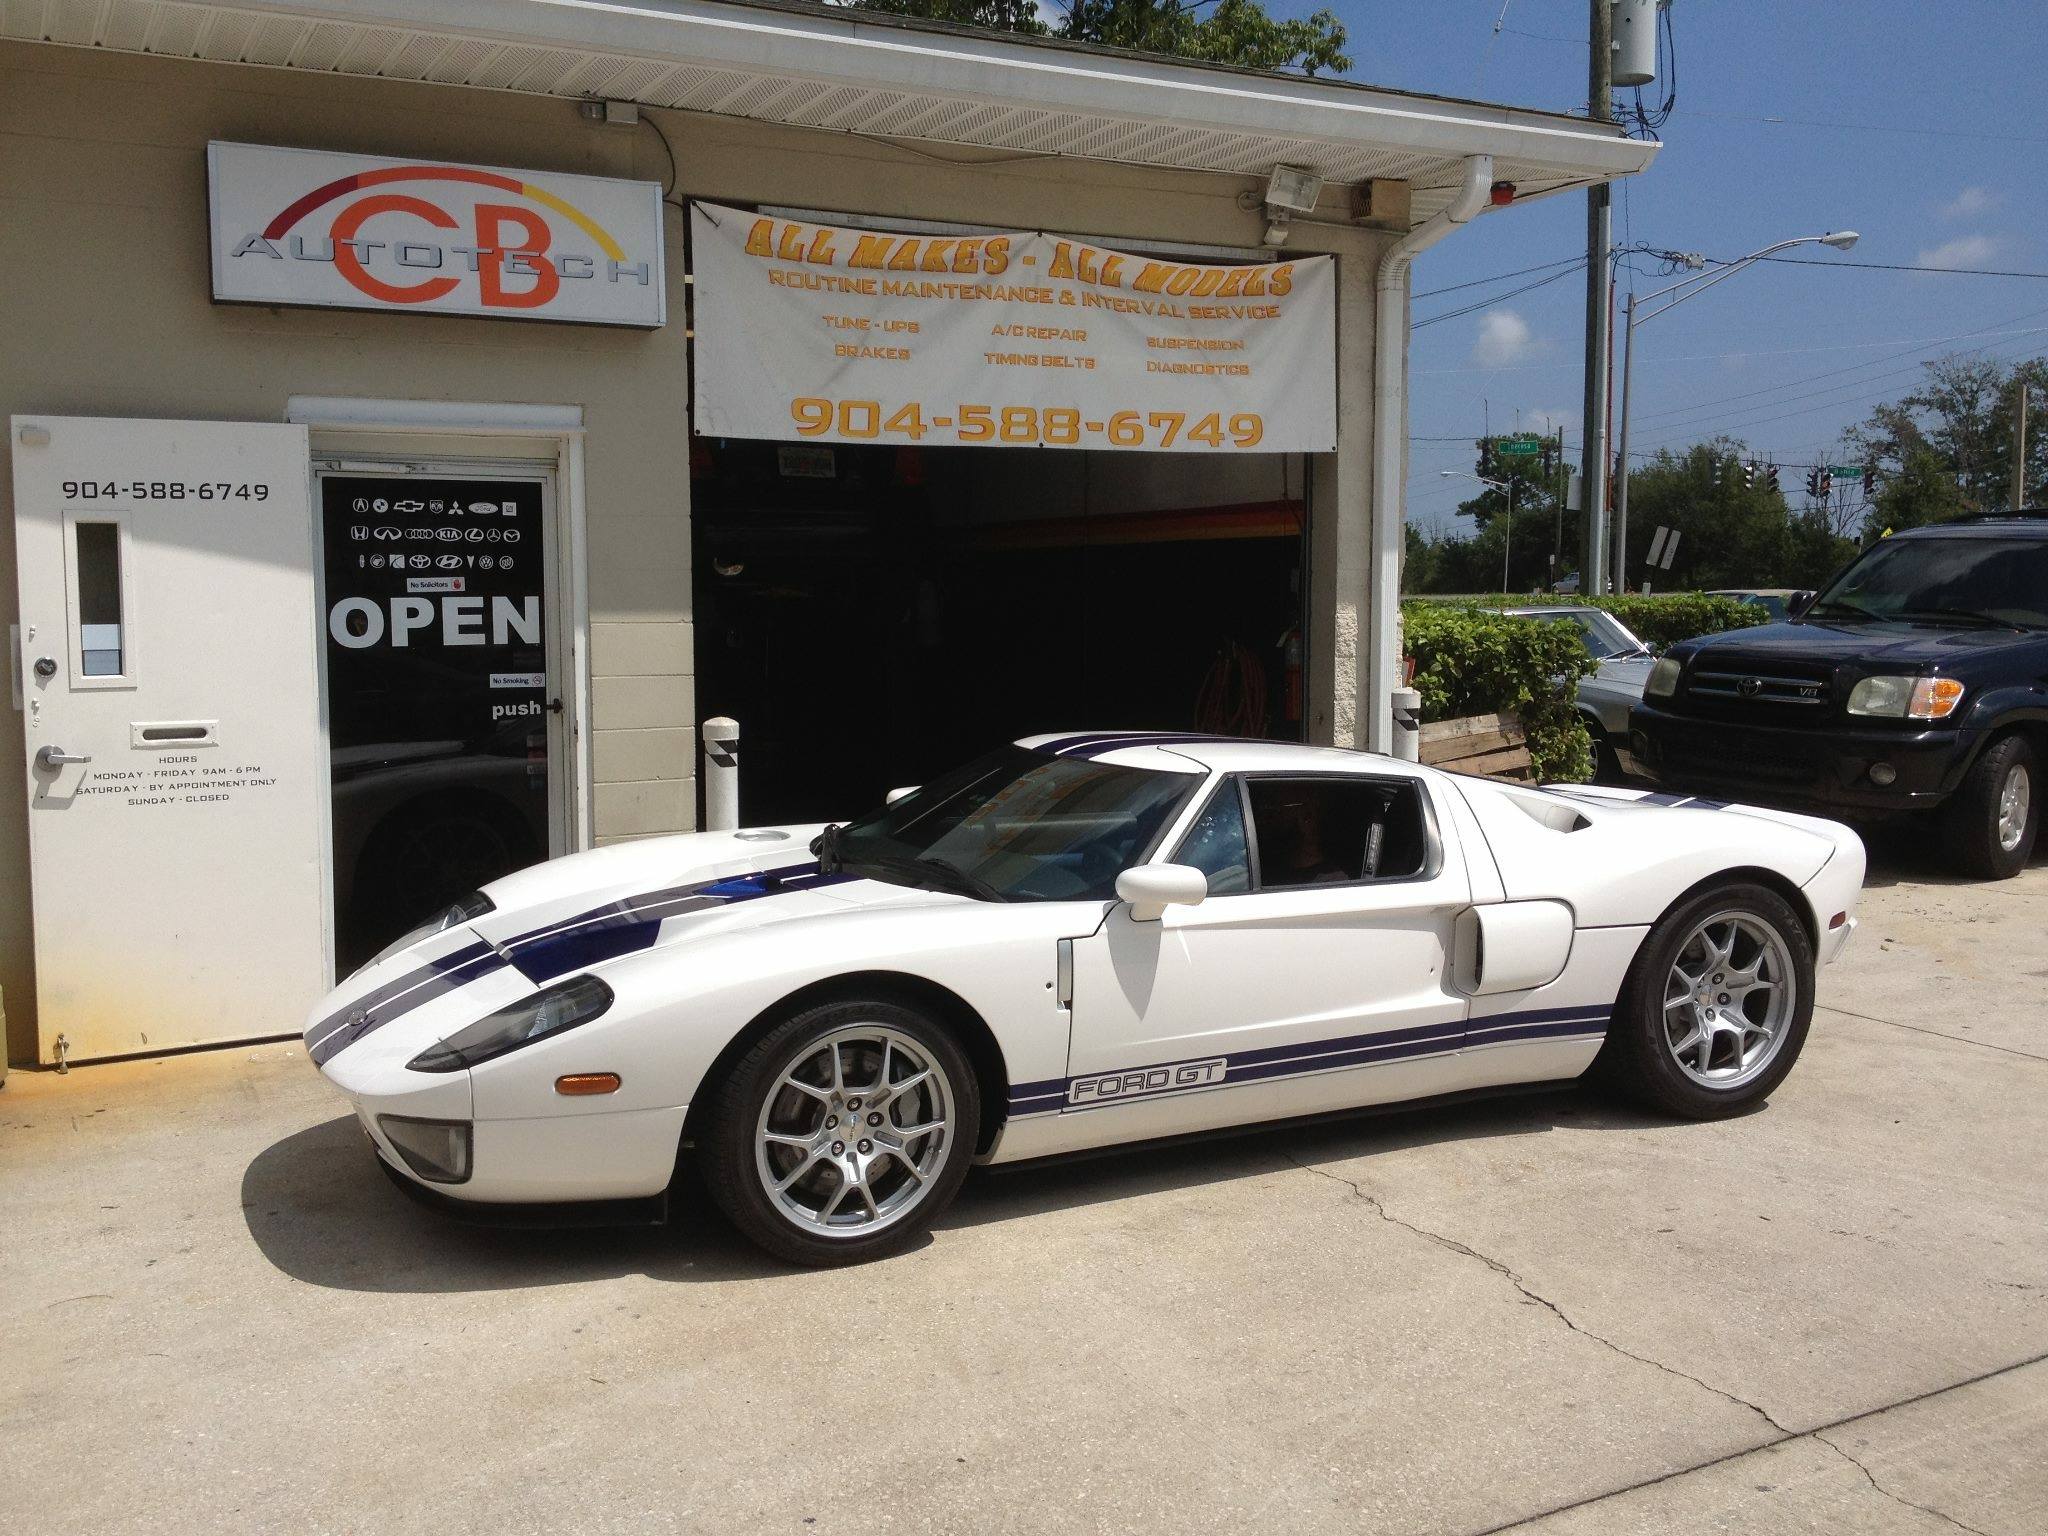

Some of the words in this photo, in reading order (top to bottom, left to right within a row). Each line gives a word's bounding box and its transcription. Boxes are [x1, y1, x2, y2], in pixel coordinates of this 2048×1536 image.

[231, 232, 649, 286] AUTOTECH
[329, 194, 560, 309] CB
[745, 218, 836, 265] ALL
[848, 235, 1010, 275] MAKES
[1048, 242, 1127, 288] ALL
[1133, 262, 1295, 298] MODELS
[768, 269, 878, 296] ROUTINE
[882, 280, 1053, 304] MAINTENANCE
[1059, 288, 1077, 306] &
[1082, 292, 1185, 319] INTERVAL
[1189, 304, 1282, 320] SERVICE
[991, 323, 1024, 336] A/C
[1026, 326, 1088, 342] REPAIR
[834, 343, 911, 361] BRAKES
[1146, 336, 1244, 351] SUSPENSION
[984, 352, 1039, 367] TIMING
[1041, 354, 1096, 370] BELTS
[1146, 360, 1250, 376] DIAGNOSTICS
[791, 397, 1264, 448] 904-588-6749
[62, 481, 269, 501] 904-588-6749
[329, 596, 541, 649] OPEN
[502, 677, 530, 685] Smoking
[1799, 687, 1818, 697] V8
[492, 700, 541, 720] push
[159, 755, 198, 764] HOURS
[93, 771, 143, 781] MONDAY
[154, 769, 196, 778] FRIDAY
[202, 768, 226, 776] 9AM
[76, 785, 139, 795] SATURDAY
[168, 779, 247, 790] APPOINTMENT
[250, 778, 277, 786] ONLY
[128, 796, 175, 806] SUNDAY
[185, 794, 230, 803] CLOSED
[1073, 1068, 1169, 1100] FORD
[1175, 1061, 1223, 1085] GT
